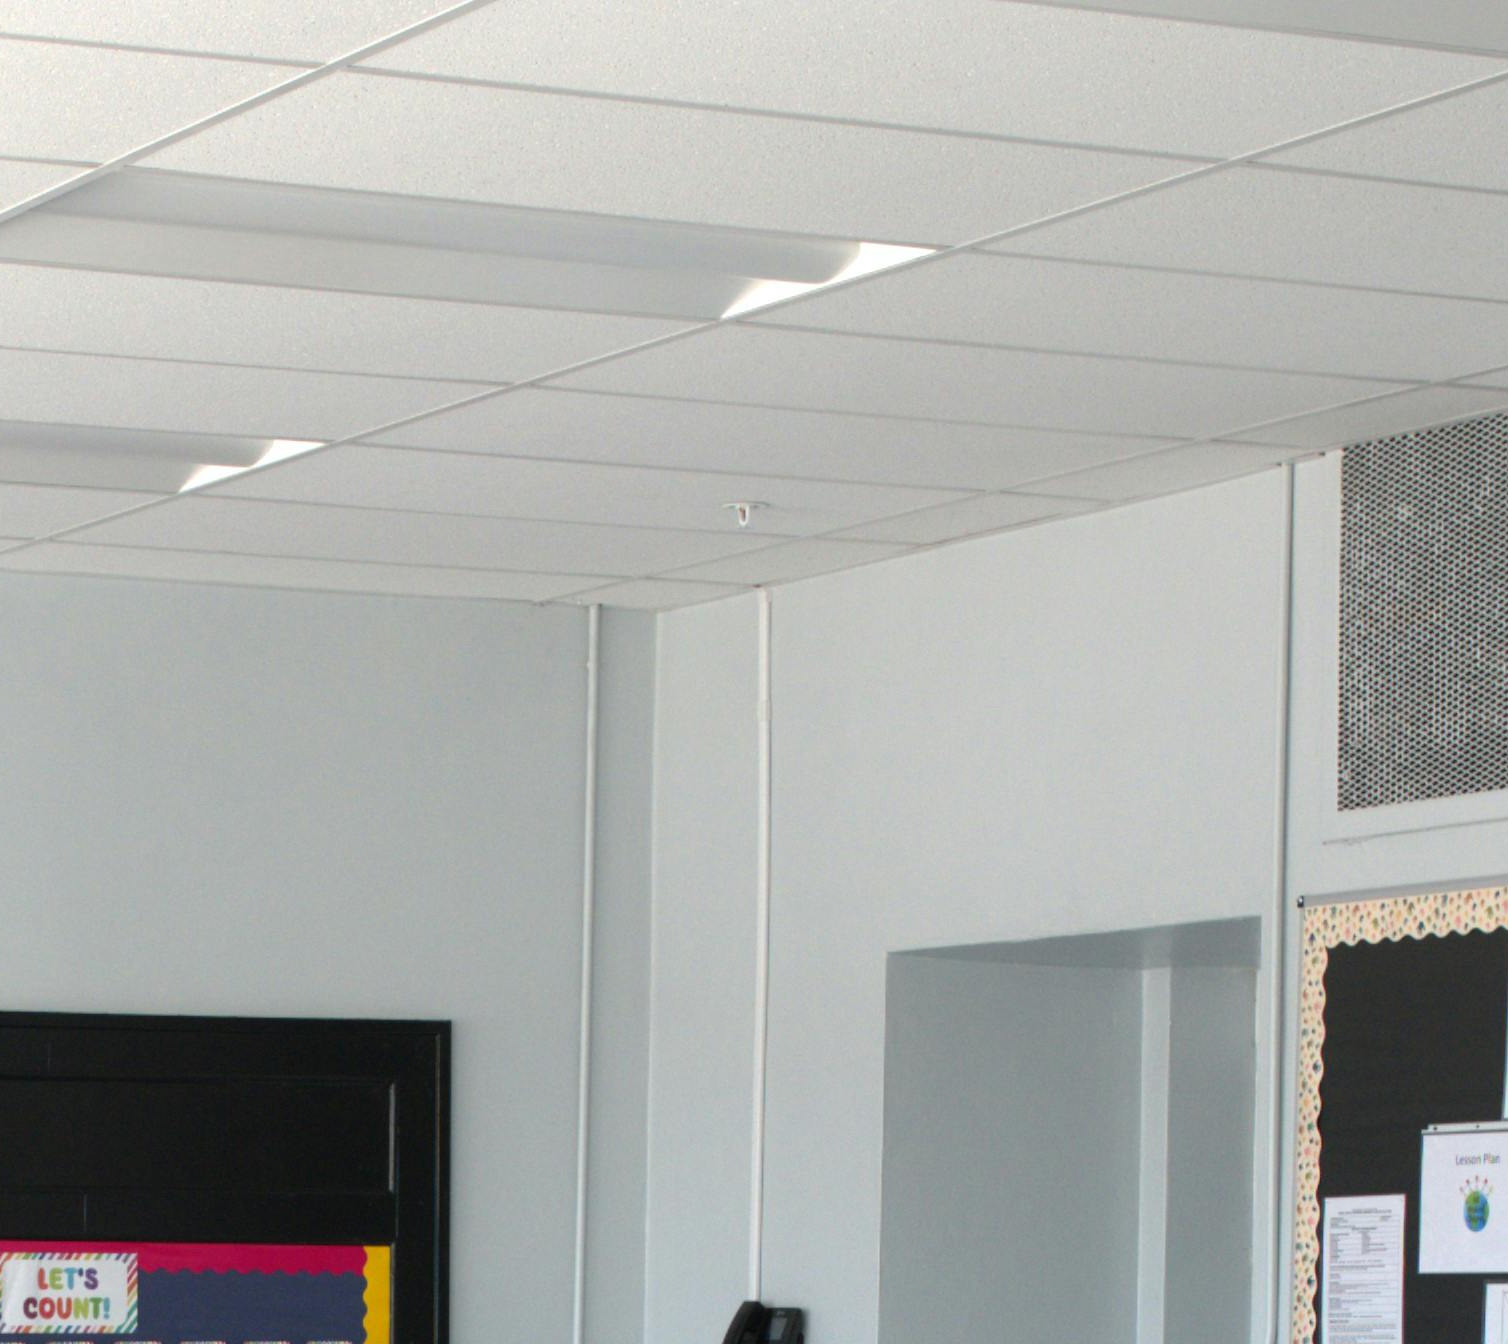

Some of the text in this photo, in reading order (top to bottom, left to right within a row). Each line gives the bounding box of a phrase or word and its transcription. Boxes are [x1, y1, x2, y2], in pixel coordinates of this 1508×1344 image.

[1456, 1152, 1500, 1166] Lesson Plan
[38, 1268, 98, 1290] LET'S
[23, 1297, 111, 1319] COUNT!
